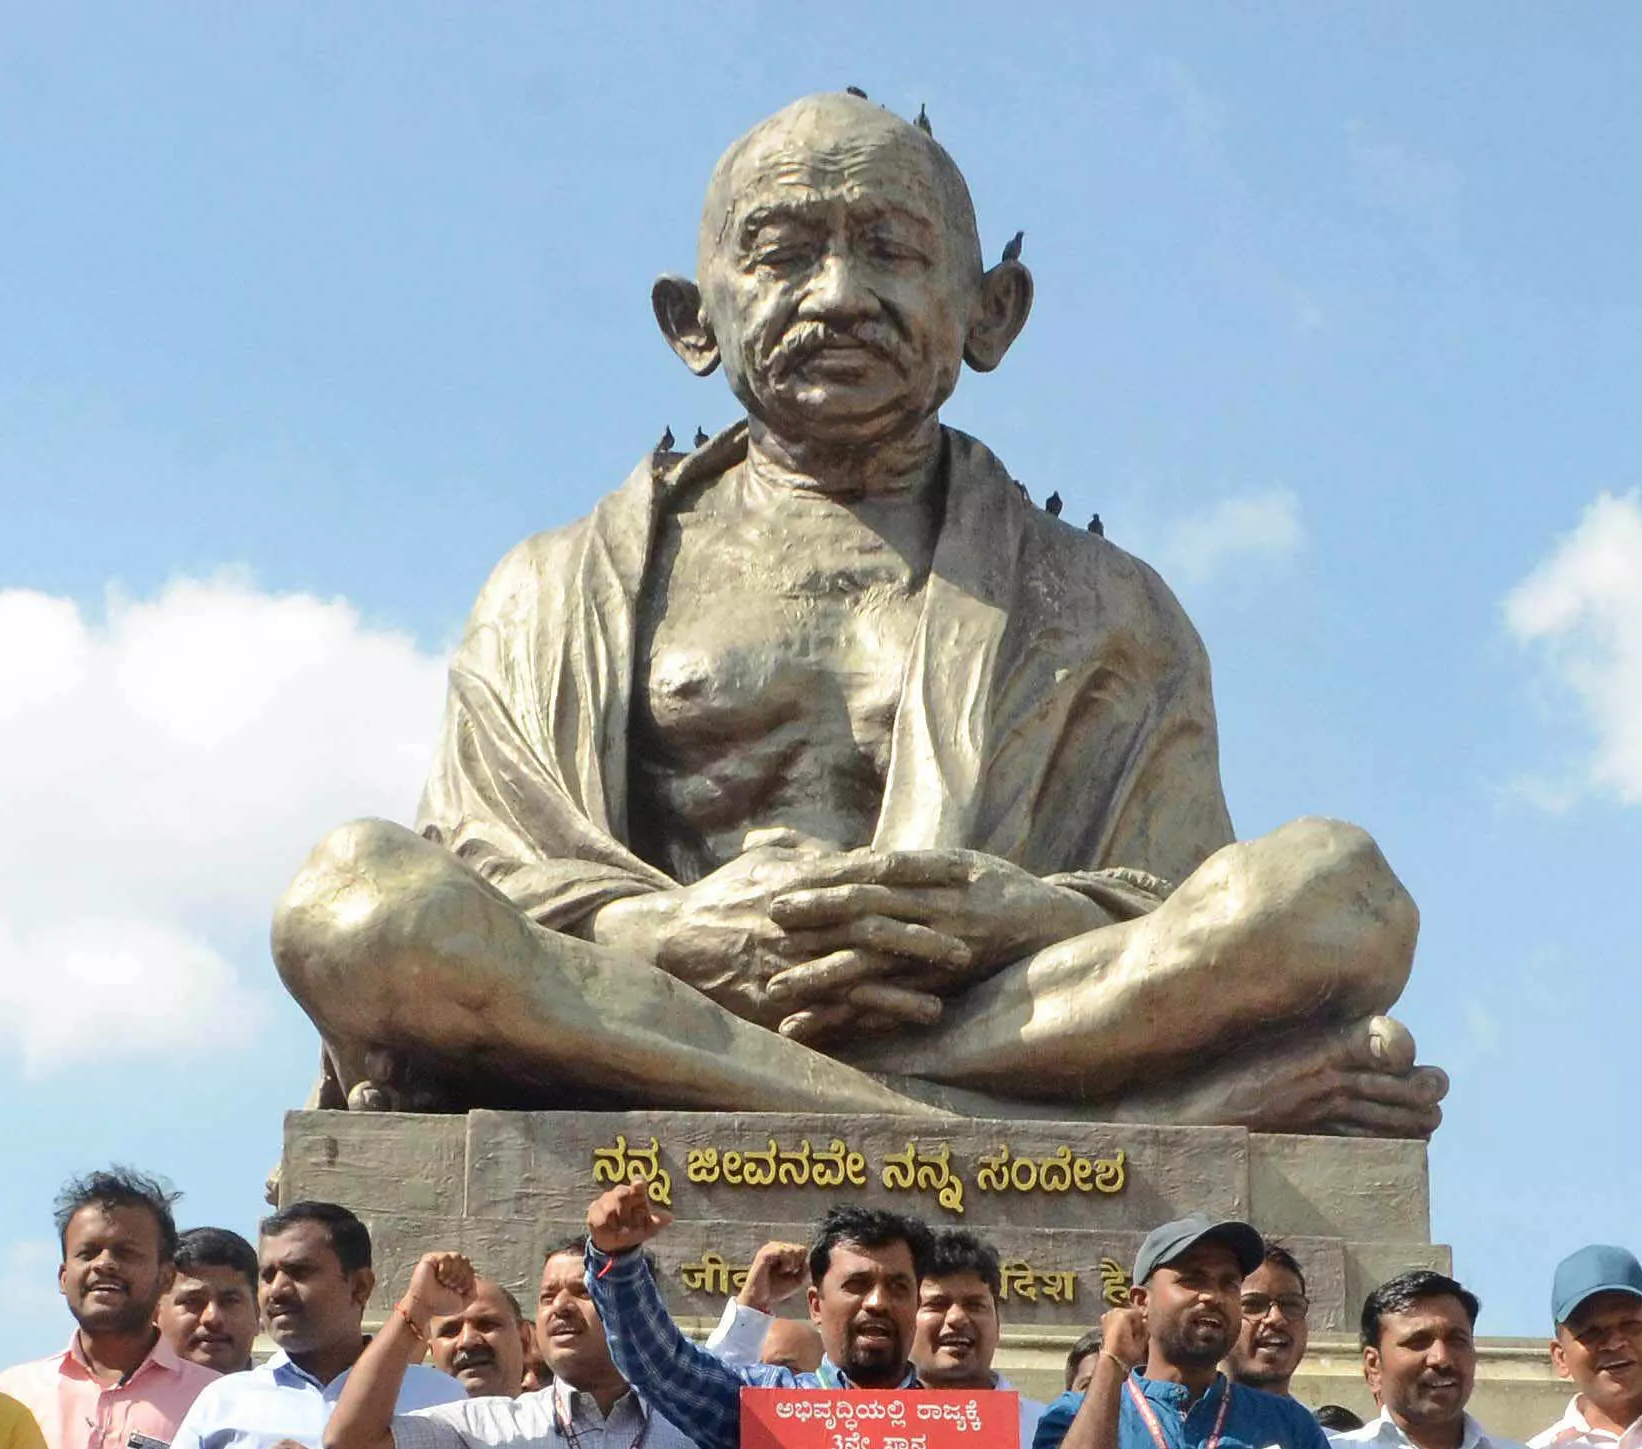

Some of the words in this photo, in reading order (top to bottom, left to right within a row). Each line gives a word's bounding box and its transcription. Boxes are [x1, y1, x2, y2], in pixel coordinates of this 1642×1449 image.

[593, 1134, 672, 1205] ನನ್ನ
[687, 1138, 867, 1188] ಜೀವನವೇ
[882, 1142, 964, 1213] ನನ್ನ
[978, 1143, 1125, 1193] ಸಂದೇಶ
[775, 1400, 906, 1430] ಅಭಿವೃದ್ಧಿಯಲ್ಲಿ
[916, 1399, 982, 1431] ರಾಜ್ಯಕ್ಕೆ
